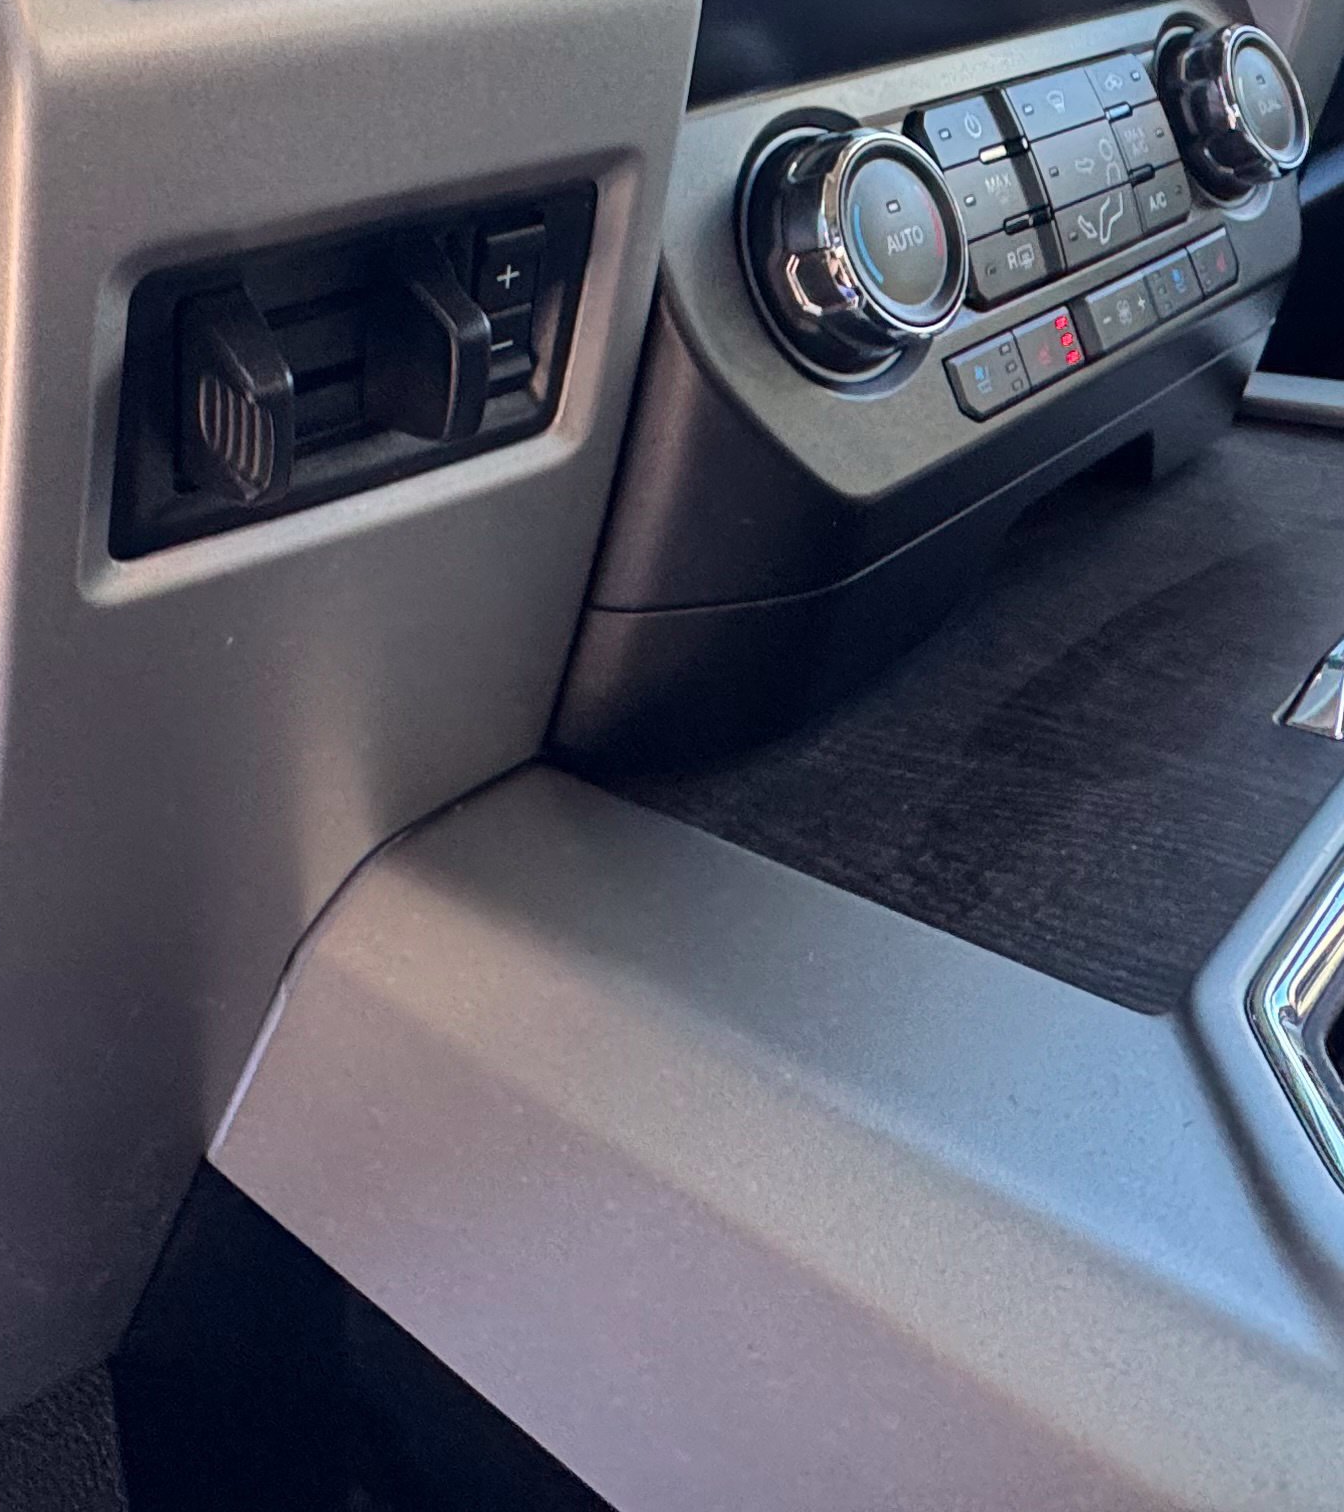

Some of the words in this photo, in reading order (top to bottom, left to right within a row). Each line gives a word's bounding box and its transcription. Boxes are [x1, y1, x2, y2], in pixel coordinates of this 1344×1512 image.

[984, 174, 1012, 193] MAX
[1149, 191, 1167, 212] A/C
[886, 224, 924, 255] AUTO
